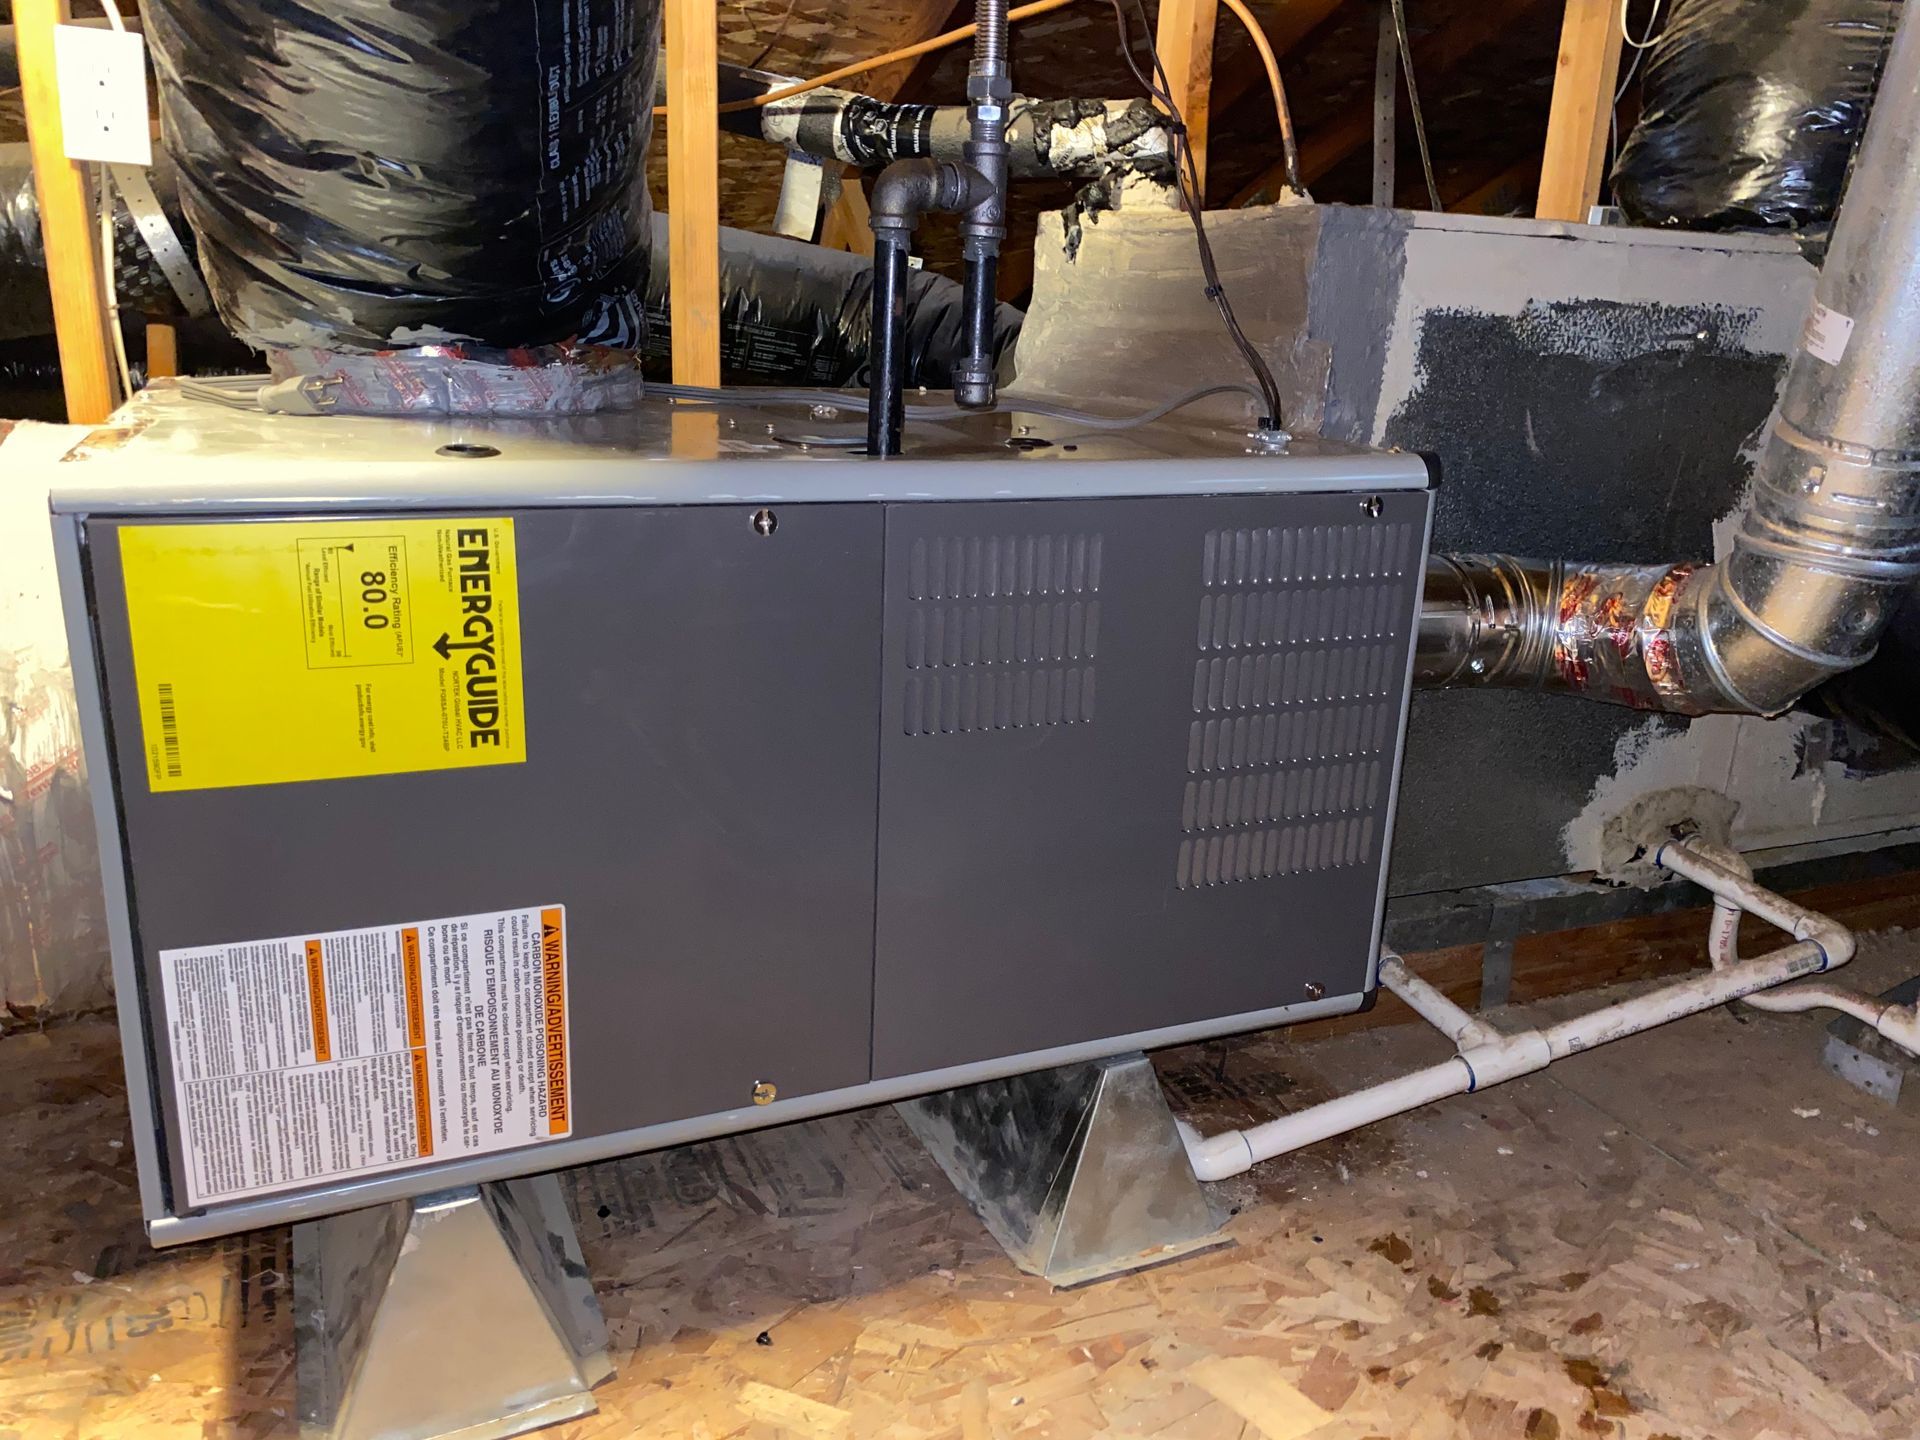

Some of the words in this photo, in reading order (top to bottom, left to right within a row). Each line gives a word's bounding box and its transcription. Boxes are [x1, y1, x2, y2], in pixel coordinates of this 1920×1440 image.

[443, 529, 452, 552] Natural
[435, 529, 445, 582] Non-Weatherized
[445, 553, 453, 566] Gas
[312, 568, 321, 586] Range
[386, 545, 400, 594] Efficiency
[445, 567, 454, 592] Furnace
[314, 595, 324, 615] Similar
[359, 570, 389, 629] 80.0
[390, 596, 402, 628] Rating
[316, 616, 325, 637] Models
[456, 528, 500, 748] ENERGYGUIDE
[438, 667, 446, 688] Model
[451, 670, 460, 697] NORTEK
[453, 697, 461, 718] Global
[454, 718, 462, 736] HVAC
[455, 737, 463, 749] LLC
[426, 925, 435, 936] Ce
[449, 922, 458, 933] de
[459, 921, 468, 930] Si
[495, 917, 505, 933] This
[509, 915, 518, 936] could
[519, 913, 529, 939] Failure
[460, 931, 468, 942] ce
[483, 928, 494, 966] RISQUE
[520, 941, 529, 949] to
[442, 944, 449, 954] ou
[450, 933, 460, 974] réparation,
[496, 934, 507, 982] compartment
[510, 937, 519, 958] result
[530, 931, 541, 973] CARBON
[427, 937, 438, 988] compartiment
[442, 955, 450, 965] de
[460, 943, 471, 994] compartiment
[511, 959, 520, 967] in
[521, 951, 530, 969] keep
[443, 966, 451, 986] mort.
[511, 967, 521, 993] carbon
[522, 970, 531, 985] this
[406, 943, 421, 1040] WARNING/ADVERTISSEMENT
[430, 989, 439, 1004] doit
[499, 982, 508, 1001] must
[532, 975, 544, 1026] MONOXIDE
[309, 956, 326, 1055] WARNING/ADVERTISSEMENT
[453, 991, 463, 1015] risque
[463, 995, 473, 1014] n'est
[474, 1004, 483, 1019] DE
[500, 1001, 509, 1012] be
[513, 993, 523, 1028] monoxide
[522, 986, 533, 1034] compartment
[464, 1015, 473, 1030] pas
[485, 967, 500, 1066] D'EMPOISONNEMENT
[500, 1011, 510, 1036] closed
[432, 1020, 442, 1041] fermé
[543, 939, 566, 1122] WARNING/ADVERTISSEMENT
[433, 1041, 443, 1058] sauf
[455, 1015, 466, 1081] d'empoisonnement
[465, 1031, 475, 1052] fermé
[475, 1019, 486, 1067] CARBONE
[502, 1036, 511, 1060] except
[514, 1029, 525, 1063] poisoning
[525, 1035, 535, 1059] closed
[534, 1026, 546, 1078] POISONING
[369, 1057, 377, 1069] this
[386, 1054, 394, 1077] service
[394, 1053, 403, 1079] certified
[402, 1052, 410, 1066] Risk
[434, 1058, 443, 1068] au
[467, 1053, 475, 1064] en
[516, 1063, 525, 1072] or
[403, 1067, 411, 1075] of
[467, 1064, 476, 1080] tout
[490, 1067, 500, 1081] AU
[503, 1060, 512, 1080] when
[526, 1060, 536, 1084] except
[370, 1069, 379, 1101] appliance.
[379, 1076, 387, 1089] and
[396, 1080, 403, 1088] or
[404, 1076, 412, 1087] fire
[405, 1088, 412, 1096] or
[435, 1067, 445, 1097] moment
[459, 1081, 467, 1092] ou
[517, 1072, 526, 1094] death.
[380, 1090, 389, 1114] provide
[388, 1079, 396, 1110] personnel
[437, 1097, 446, 1108] de
[468, 1080, 478, 1105] temps,
[504, 1079, 514, 1113] servicing.
[527, 1085, 537, 1104] when
[537, 1079, 548, 1118] HAZARD
[397, 1089, 406, 1131] manufacturer
[405, 1097, 414, 1120] electric
[414, 1062, 428, 1153] WARNING/ADVERTISSEMENT
[459, 1092, 469, 1127] monoxyde
[470, 1106, 479, 1122] sauf
[491, 1082, 503, 1134] MONOXYDE
[391, 1127, 398, 1136] be
[407, 1121, 415, 1141] shock.
[438, 1107, 448, 1144] l'entretien.
[461, 1127, 470, 1135] le
[471, 1122, 479, 1133] en
[528, 1105, 538, 1137] servicing
[382, 1115, 391, 1154] maintenance
[400, 1131, 408, 1159] qualified
[462, 1134, 470, 1149] car-
[471, 1134, 480, 1147] cas
[385, 1154, 392, 1162] of
